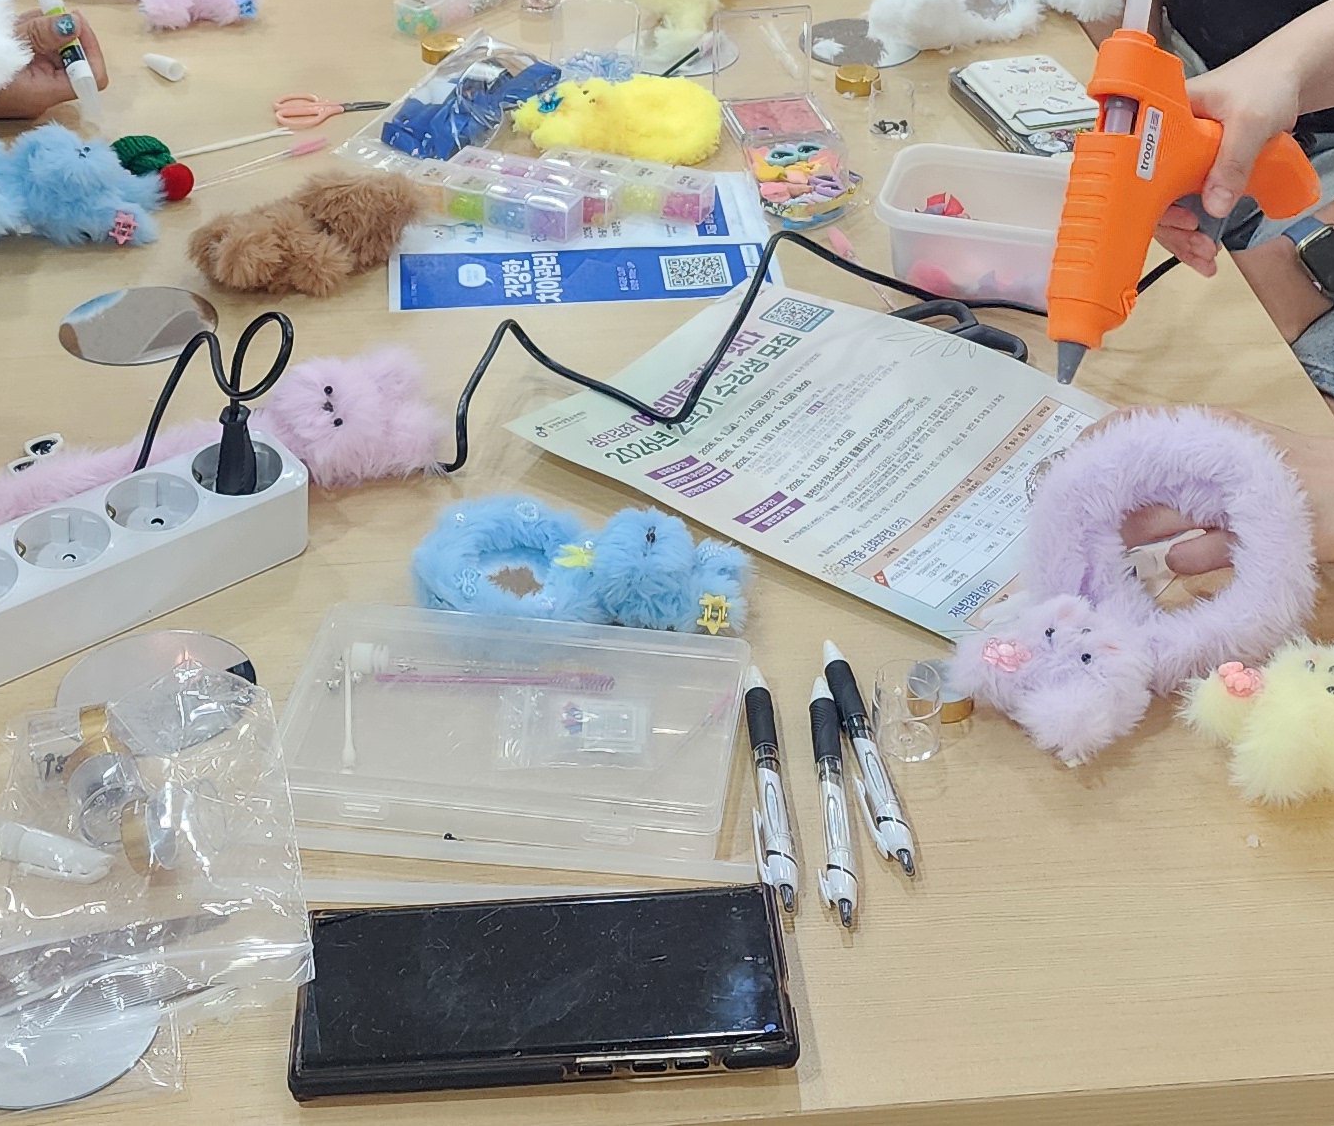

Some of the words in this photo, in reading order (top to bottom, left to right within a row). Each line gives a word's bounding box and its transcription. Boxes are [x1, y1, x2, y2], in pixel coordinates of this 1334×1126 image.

[1140, 133, 1156, 171] troop
[501, 258, 533, 298] 건강한
[532, 252, 563, 304] 치아관리
[601, 428, 681, 466] 2026년
[661, 394, 725, 436] 2학기
[707, 355, 773, 399] 수강생
[754, 329, 803, 361] 모집
[583, 420, 644, 449] 성인강좌
[801, 455, 854, 500] 부천여성청소년센터
[846, 435, 874, 458] 홈페이지
[865, 417, 895, 439] 수강신청
[945, 590, 988, 619] 저녁강좌
[975, 577, 1002, 596] (8주)
